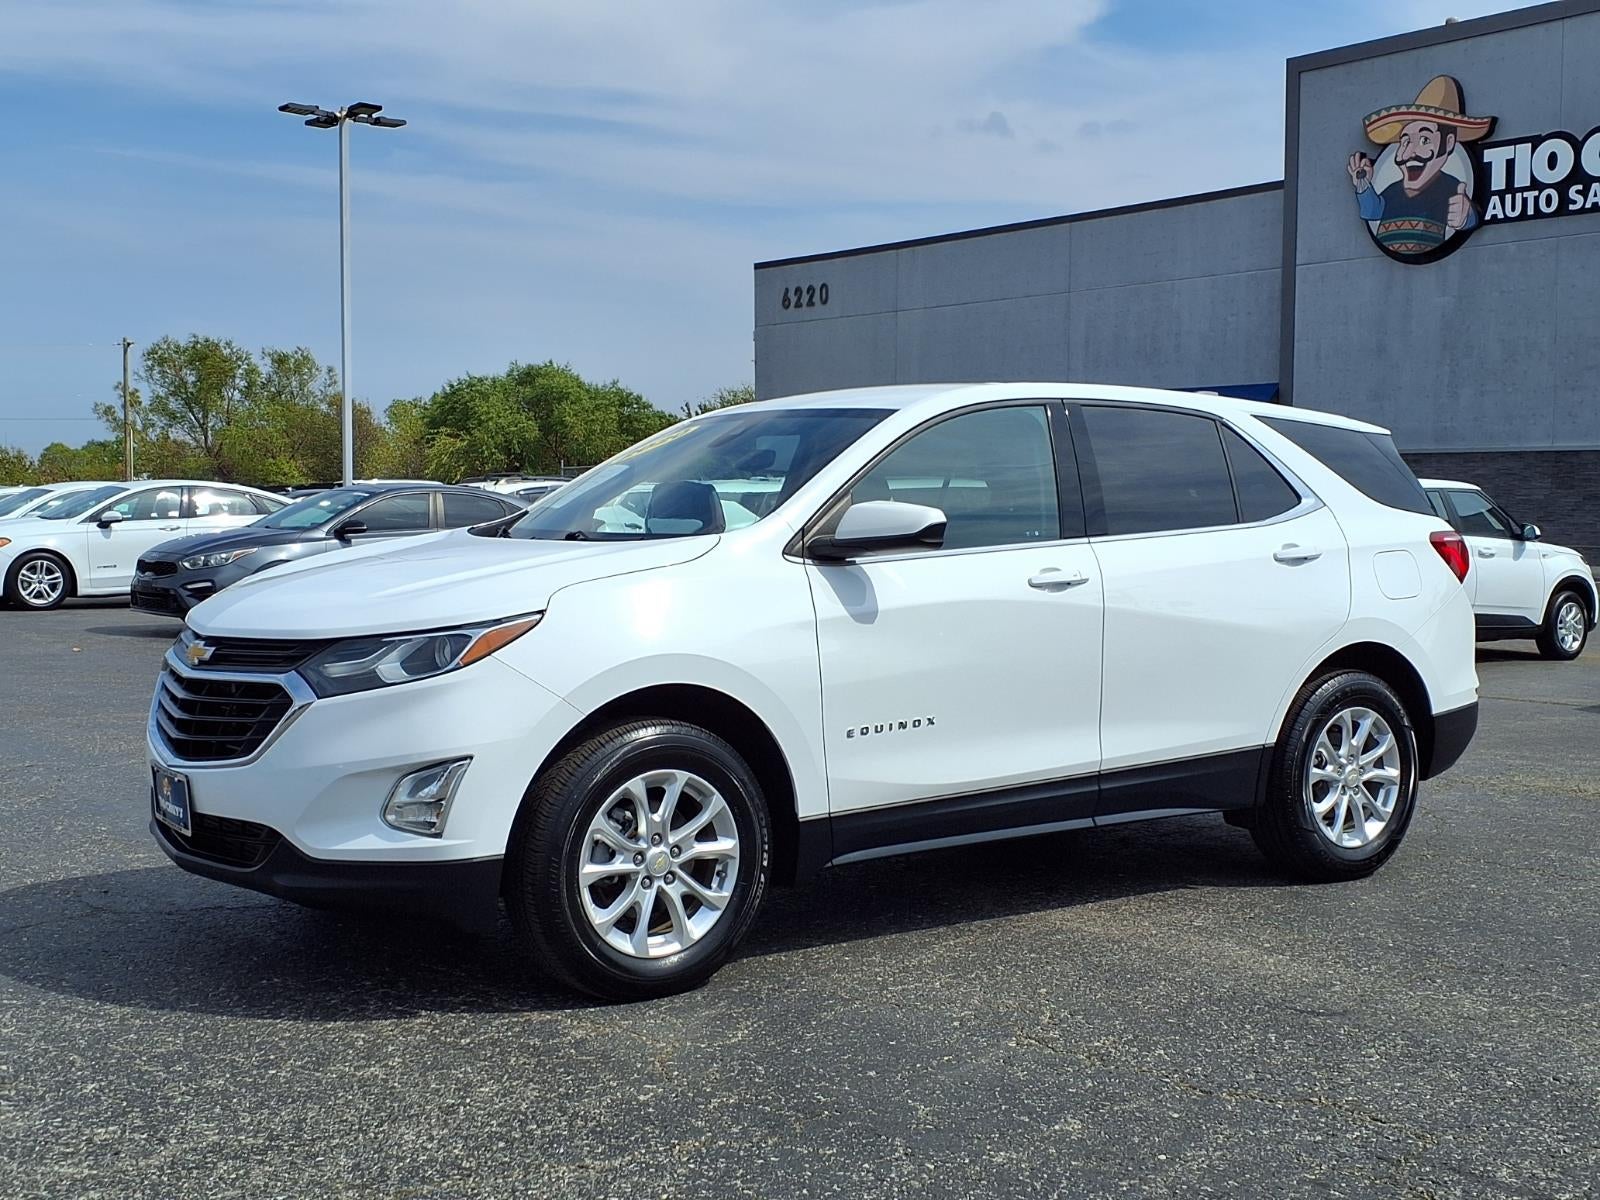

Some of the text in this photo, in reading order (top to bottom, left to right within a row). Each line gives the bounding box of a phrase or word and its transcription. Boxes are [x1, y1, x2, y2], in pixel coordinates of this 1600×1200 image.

[1483, 138, 1575, 191] TIO
[1484, 188, 1559, 221] AUTO
[781, 283, 829, 310] 6220
[846, 716, 936, 739] EQUINOX
